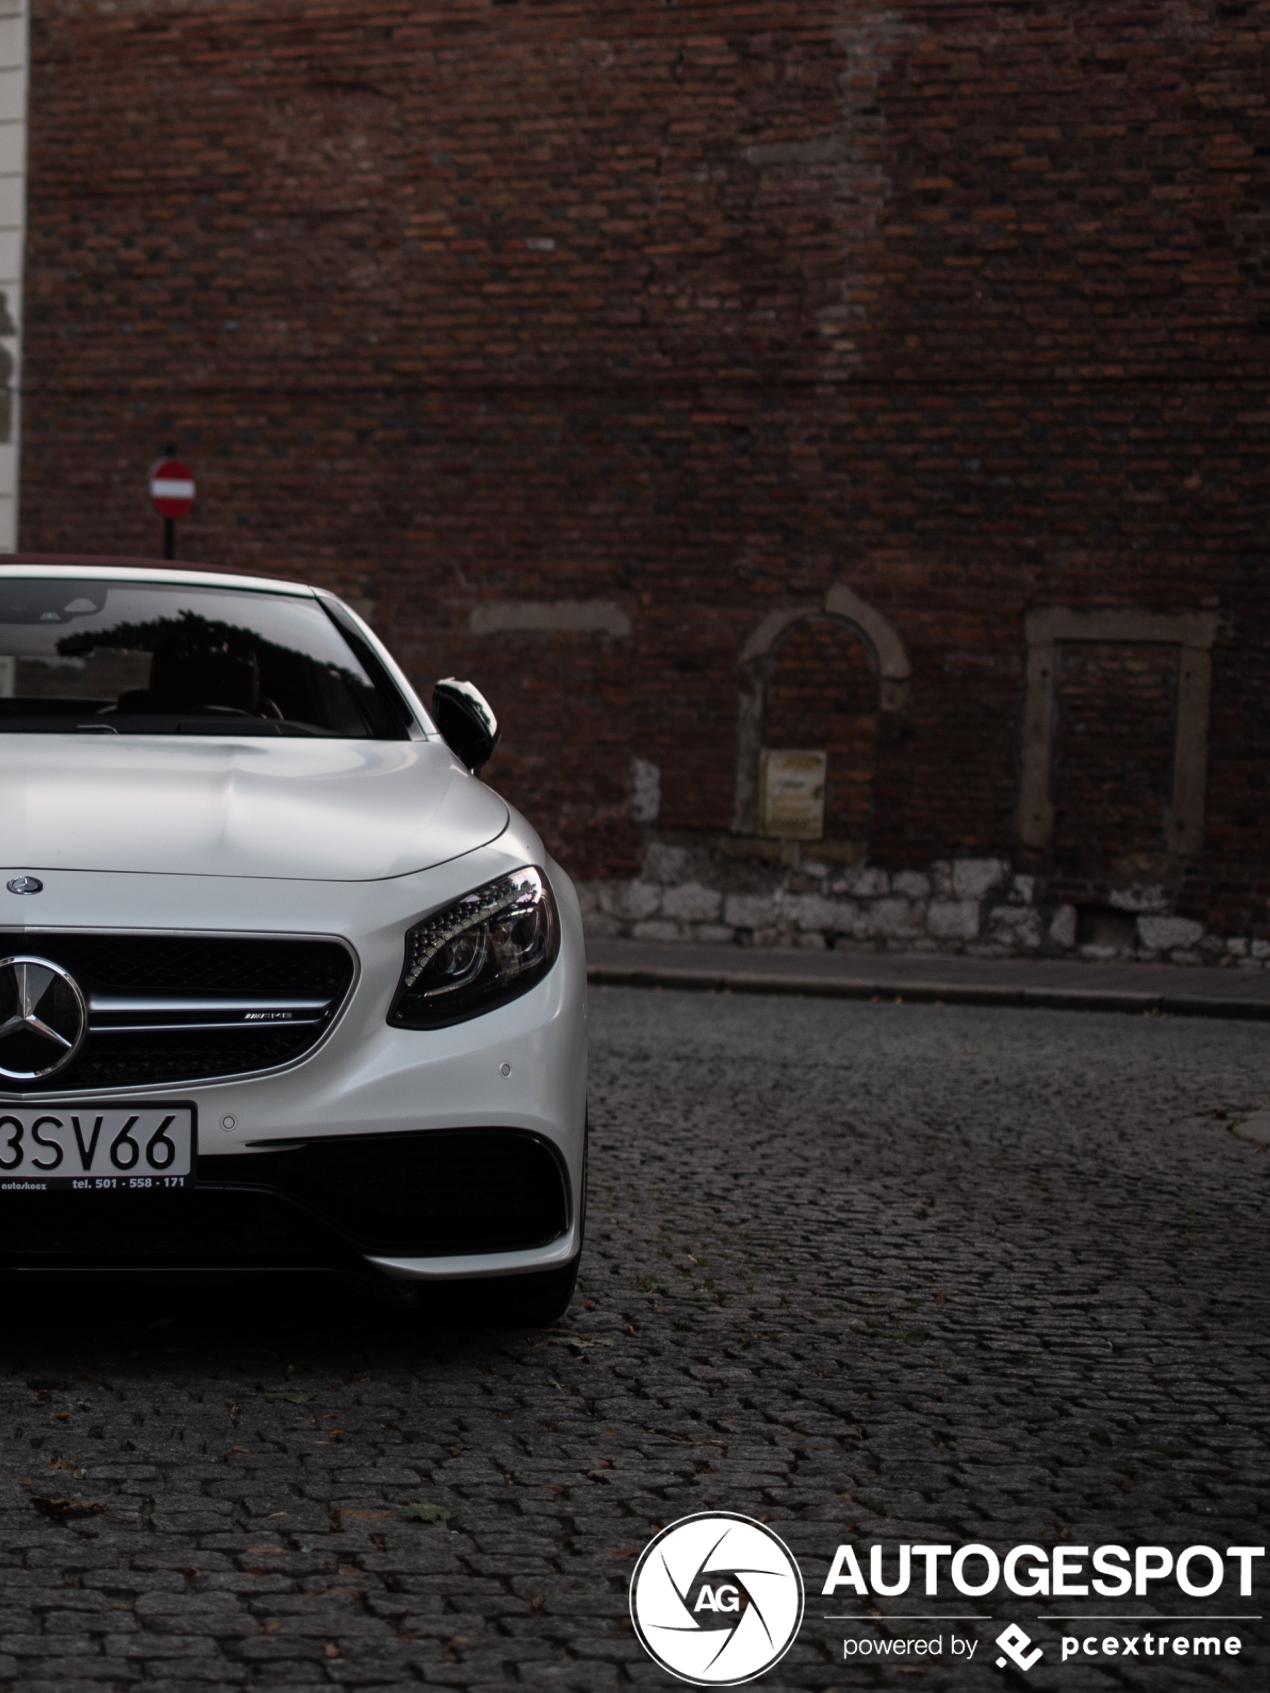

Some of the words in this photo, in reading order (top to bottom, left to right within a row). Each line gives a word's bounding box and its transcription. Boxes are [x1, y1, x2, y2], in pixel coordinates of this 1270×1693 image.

[72, 1178, 92, 1189] tel.
[95, 1178, 117, 1189] 501
[129, 1178, 153, 1188] 558
[163, 1177, 184, 1188] 171
